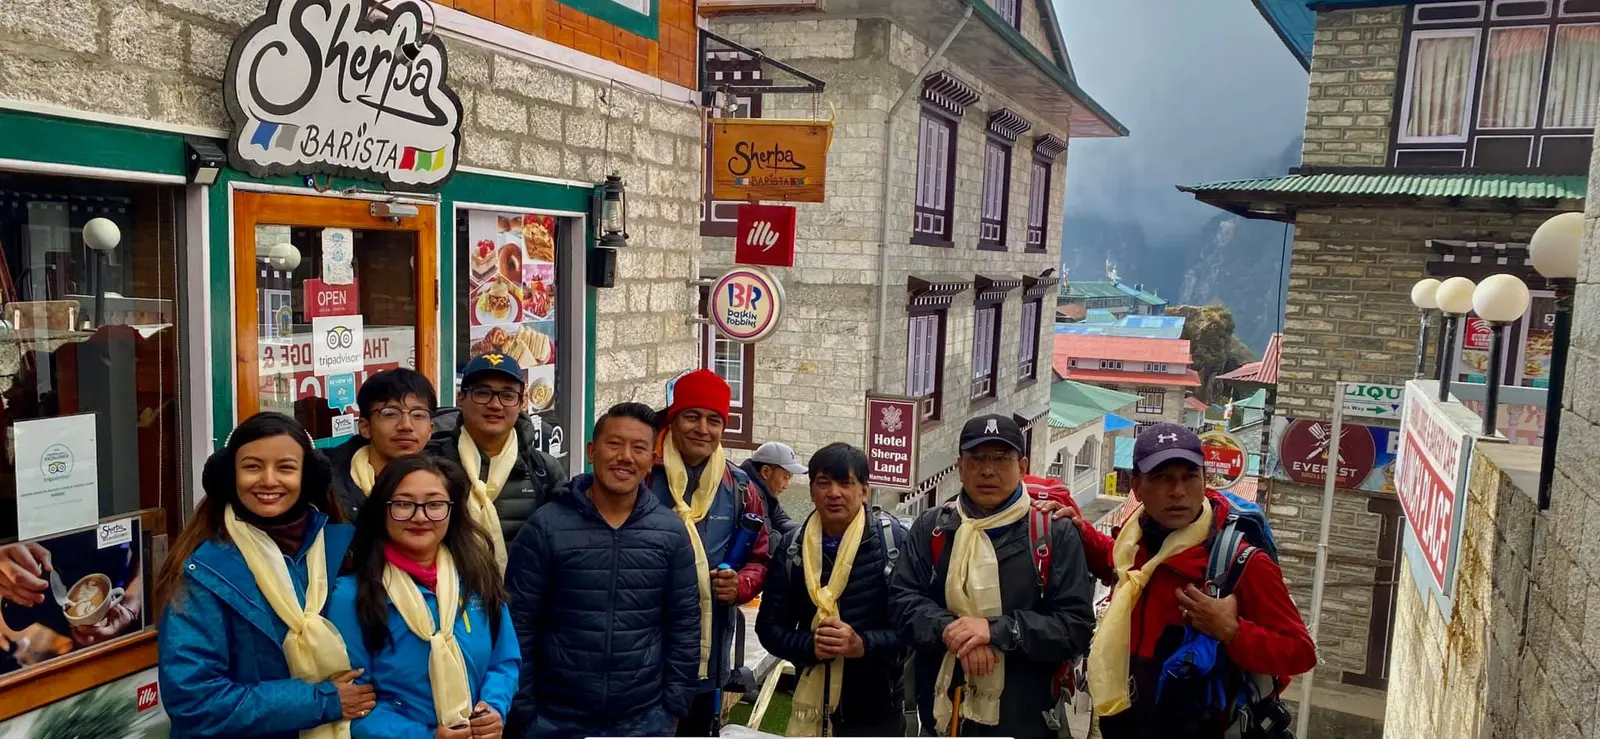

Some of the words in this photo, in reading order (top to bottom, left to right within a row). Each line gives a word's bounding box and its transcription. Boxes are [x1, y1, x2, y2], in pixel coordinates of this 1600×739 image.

[249, 0, 448, 127] Sherpa
[728, 141, 806, 176] Sherpa
[746, 220, 780, 252] illy
[318, 290, 347, 306] OPEN
[727, 282, 762, 310] BR
[319, 352, 360, 368] tripadvisor
[1345, 384, 1403, 400] LIQU
[874, 433, 906, 447] Hotel
[871, 448, 908, 462] Sherpa
[874, 461, 904, 474] Land
[1293, 461, 1358, 477] EVERST
[869, 473, 891, 482] Namche
[1417, 465, 1450, 577] PLACE
[138, 687, 157, 707] illy
